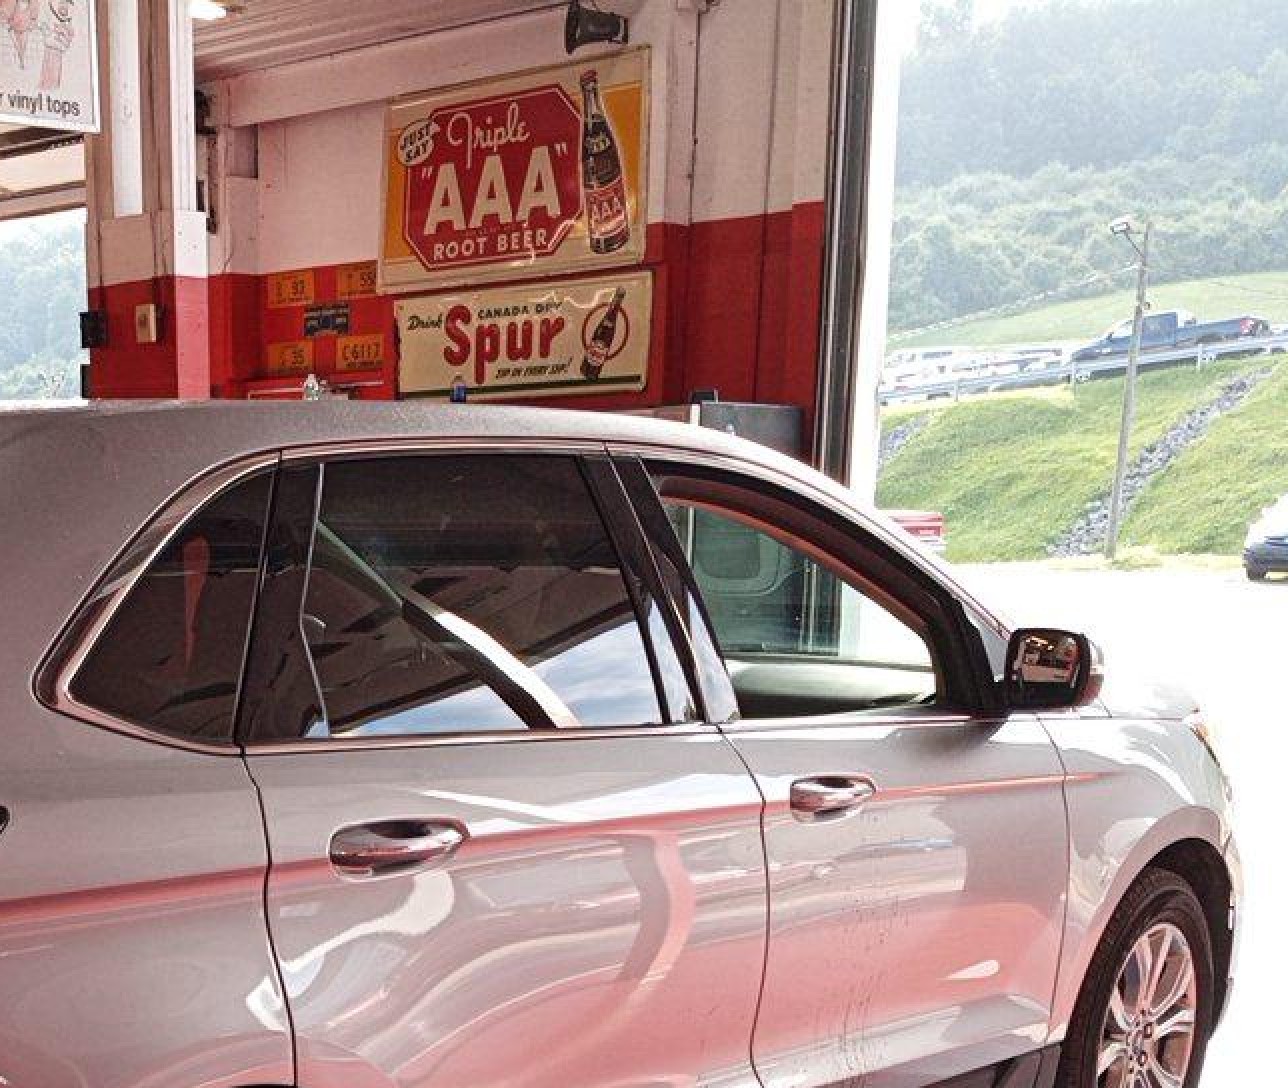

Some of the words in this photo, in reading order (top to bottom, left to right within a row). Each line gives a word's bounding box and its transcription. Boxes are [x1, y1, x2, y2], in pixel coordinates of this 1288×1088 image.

[7, 89, 43, 115] vinyl
[47, 95, 81, 118] tops
[447, 102, 530, 169] Triple
[433, 237, 487, 260] ROOT
[497, 229, 548, 252] BEER
[478, 304, 529, 319] CANADA
[444, 304, 565, 384] Spur
